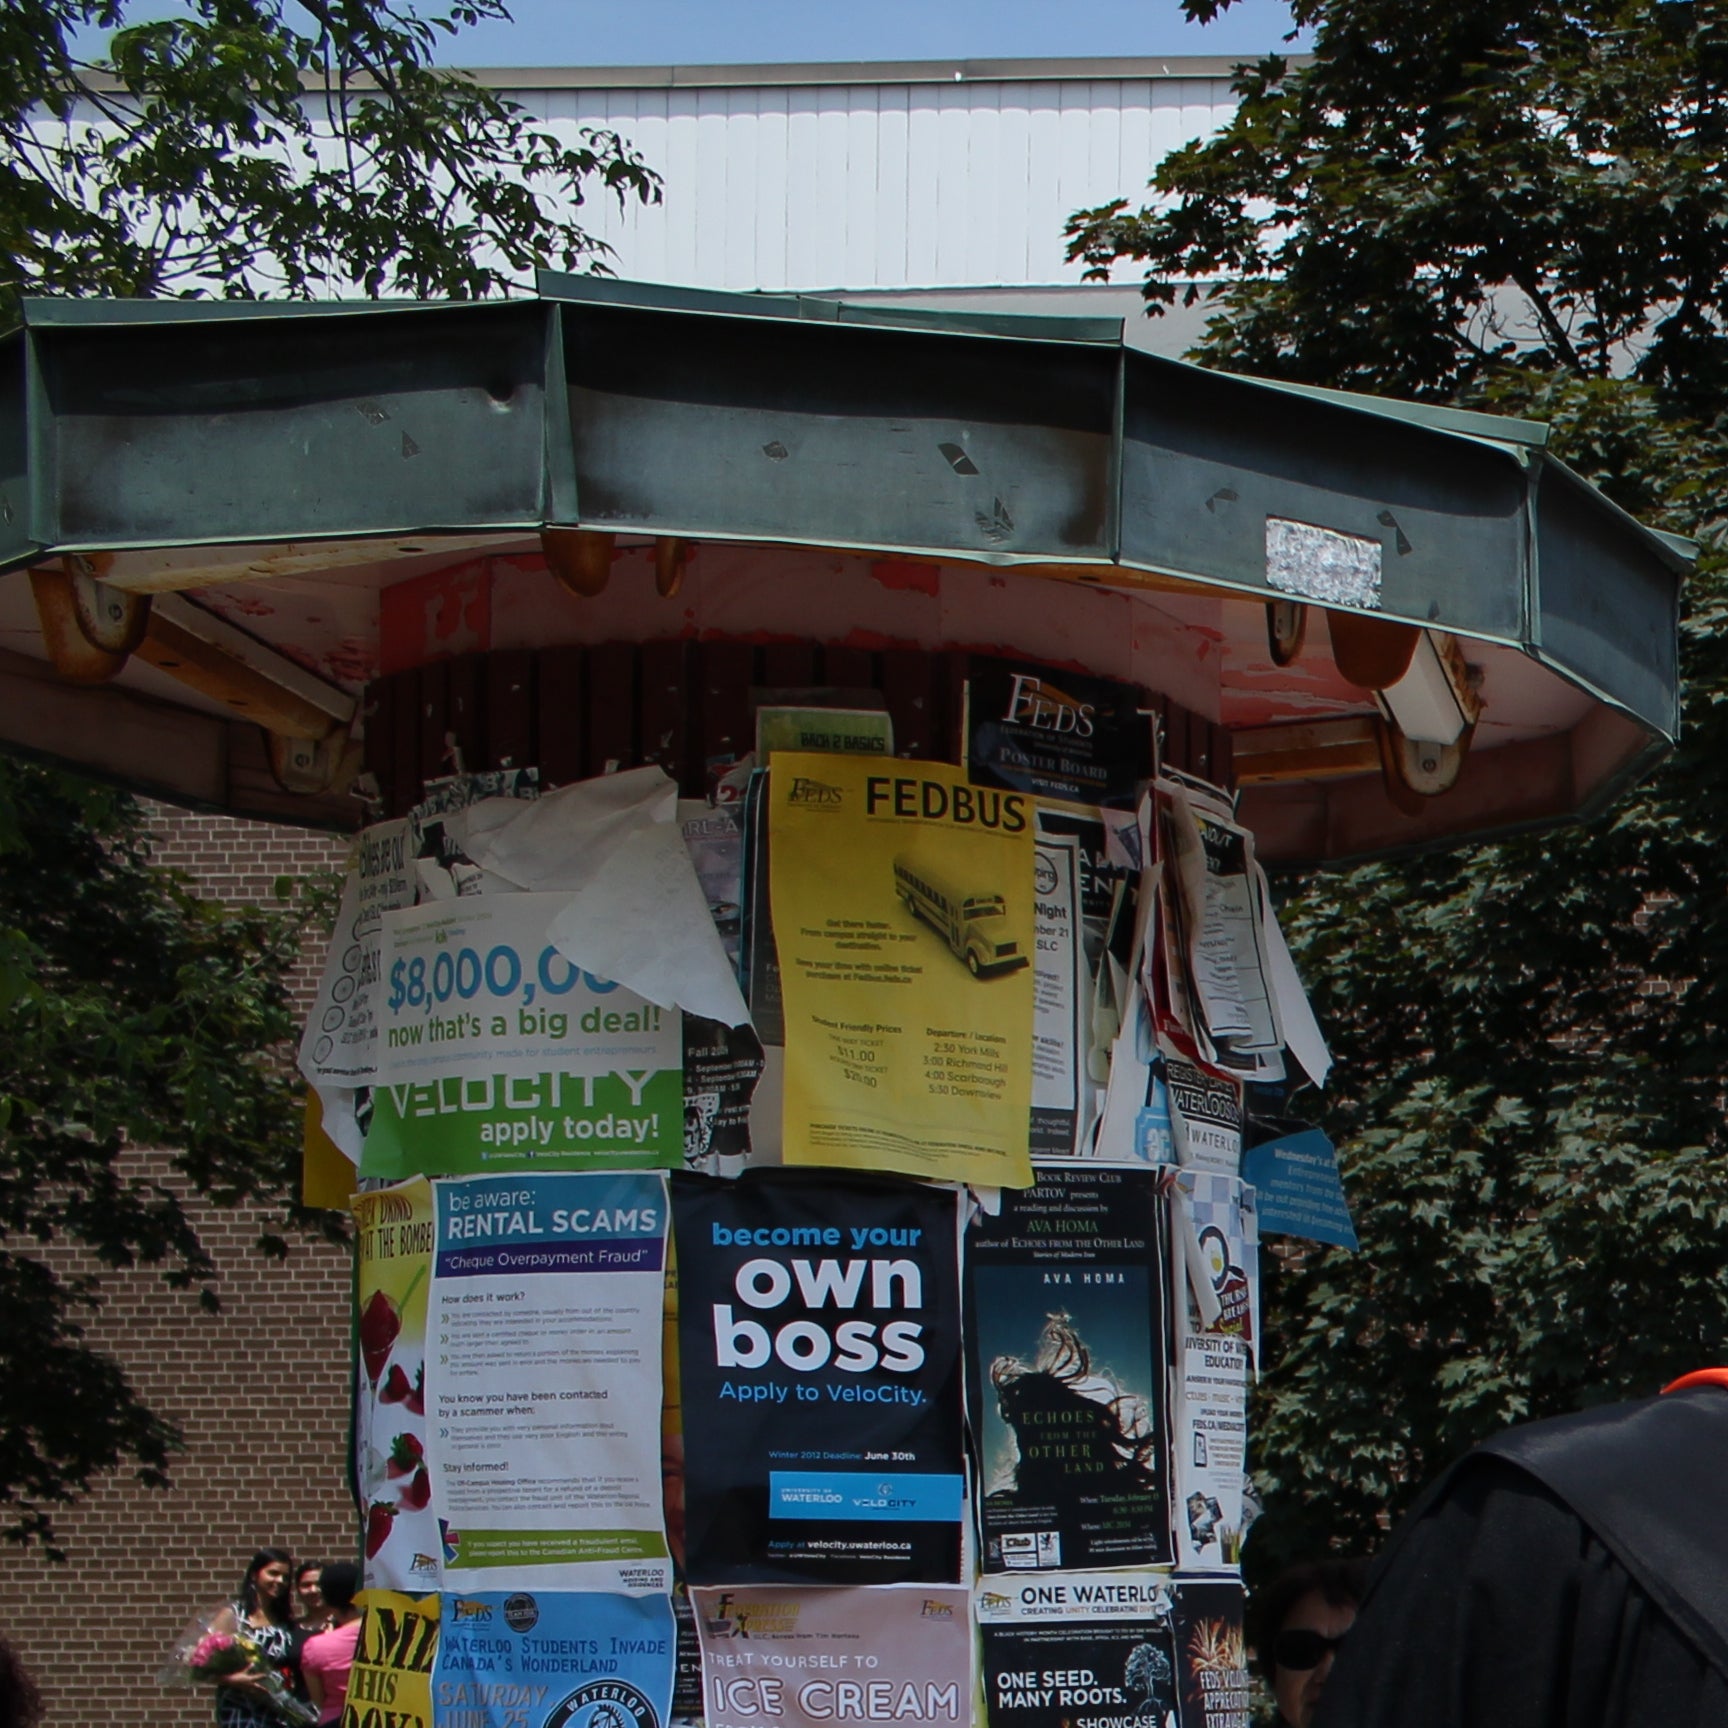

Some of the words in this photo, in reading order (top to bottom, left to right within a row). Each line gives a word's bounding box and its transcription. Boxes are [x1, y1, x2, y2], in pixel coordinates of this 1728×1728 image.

[1002, 673, 1096, 738] FEDS
[833, 734, 842, 748] 2
[844, 735, 885, 751] BASICS
[1000, 748, 1056, 771] POSTER
[1058, 757, 1108, 780] BOARD
[866, 776, 1027, 833] FEDBUS
[388, 1026, 423, 1048] now
[428, 1012, 481, 1042] that's
[491, 1017, 507, 1036] a
[519, 1009, 567, 1039] big
[580, 1005, 660, 1032] deal!
[389, 1069, 659, 1119] VELOCITY
[480, 1116, 554, 1146] apply
[563, 1113, 659, 1143] today!
[449, 1191, 470, 1212] be
[473, 1191, 536, 1209] aware:
[448, 1209, 544, 1240] RENTAL
[551, 1208, 657, 1234] SCAMS
[1027, 1220, 1052, 1233] AVA
[1056, 1220, 1098, 1233] HOMA
[712, 1222, 841, 1247] become
[850, 1226, 922, 1251] your
[498, 1251, 596, 1267] Overpayment
[735, 1258, 923, 1309] own
[1044, 1273, 1072, 1284] AVA
[1083, 1273, 1125, 1284] HOMA
[442, 1293, 462, 1305] How
[464, 1292, 483, 1303] does
[485, 1292, 493, 1302] it
[496, 1291, 525, 1302] work?
[713, 1304, 925, 1372] boss
[719, 1381, 788, 1403] Apply
[795, 1384, 818, 1400] to
[826, 1384, 927, 1406] VeloCity.
[1022, 1410, 1095, 1425] ECHOES
[864, 1452, 889, 1461] June
[891, 1452, 916, 1461] 30th
[1029, 1444, 1092, 1459] OTHER
[1064, 1462, 1104, 1474] LAND
[807, 1540, 912, 1551] velocity.uwaterloo.ca
[445, 1636, 512, 1653] WATERLOO
[522, 1637, 598, 1654] STUDENTS
[610, 1637, 666, 1655] INVADE
[442, 1654, 513, 1672] CANADA'S
[522, 1656, 618, 1673] WONDERLAND
[707, 1652, 754, 1668] TREAT
[760, 1655, 848, 1669] YOURSELF
[855, 1656, 879, 1669] TO
[997, 1672, 1037, 1689] ONE
[1043, 1670, 1098, 1687] SEED.
[566, 1686, 647, 1718] WATERLOO
[713, 1676, 784, 1717] ICE
[797, 1680, 959, 1721] CREAM
[998, 1690, 1054, 1709] MANY
[1059, 1687, 1127, 1706] ROOTS.
